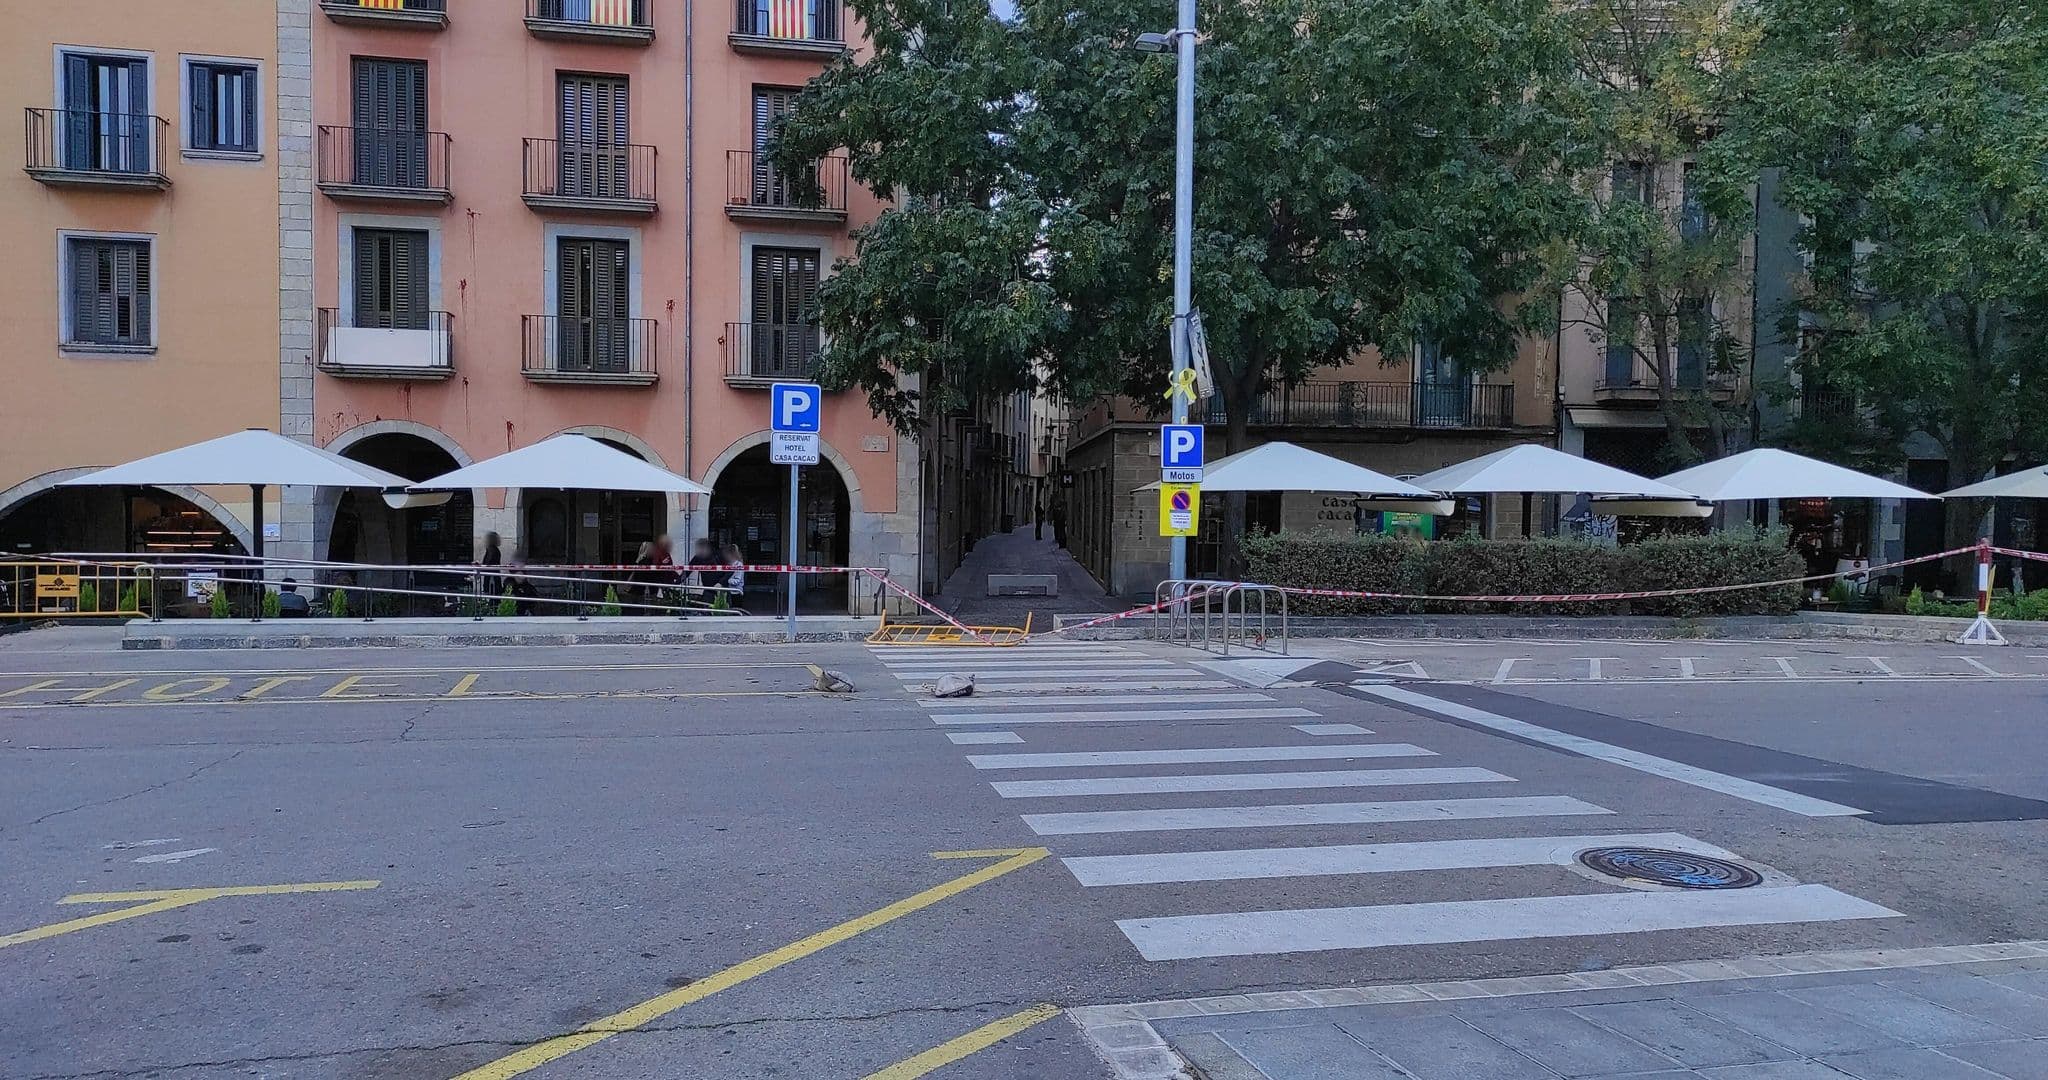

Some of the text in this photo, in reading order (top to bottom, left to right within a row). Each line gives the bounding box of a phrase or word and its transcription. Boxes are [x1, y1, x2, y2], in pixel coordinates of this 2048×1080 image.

[782, 390, 811, 426] P
[779, 434, 811, 442] RESERVAT
[1170, 430, 1195, 463] P
[1063, 474, 1073, 484] H
[1170, 471, 1195, 480] Motos
